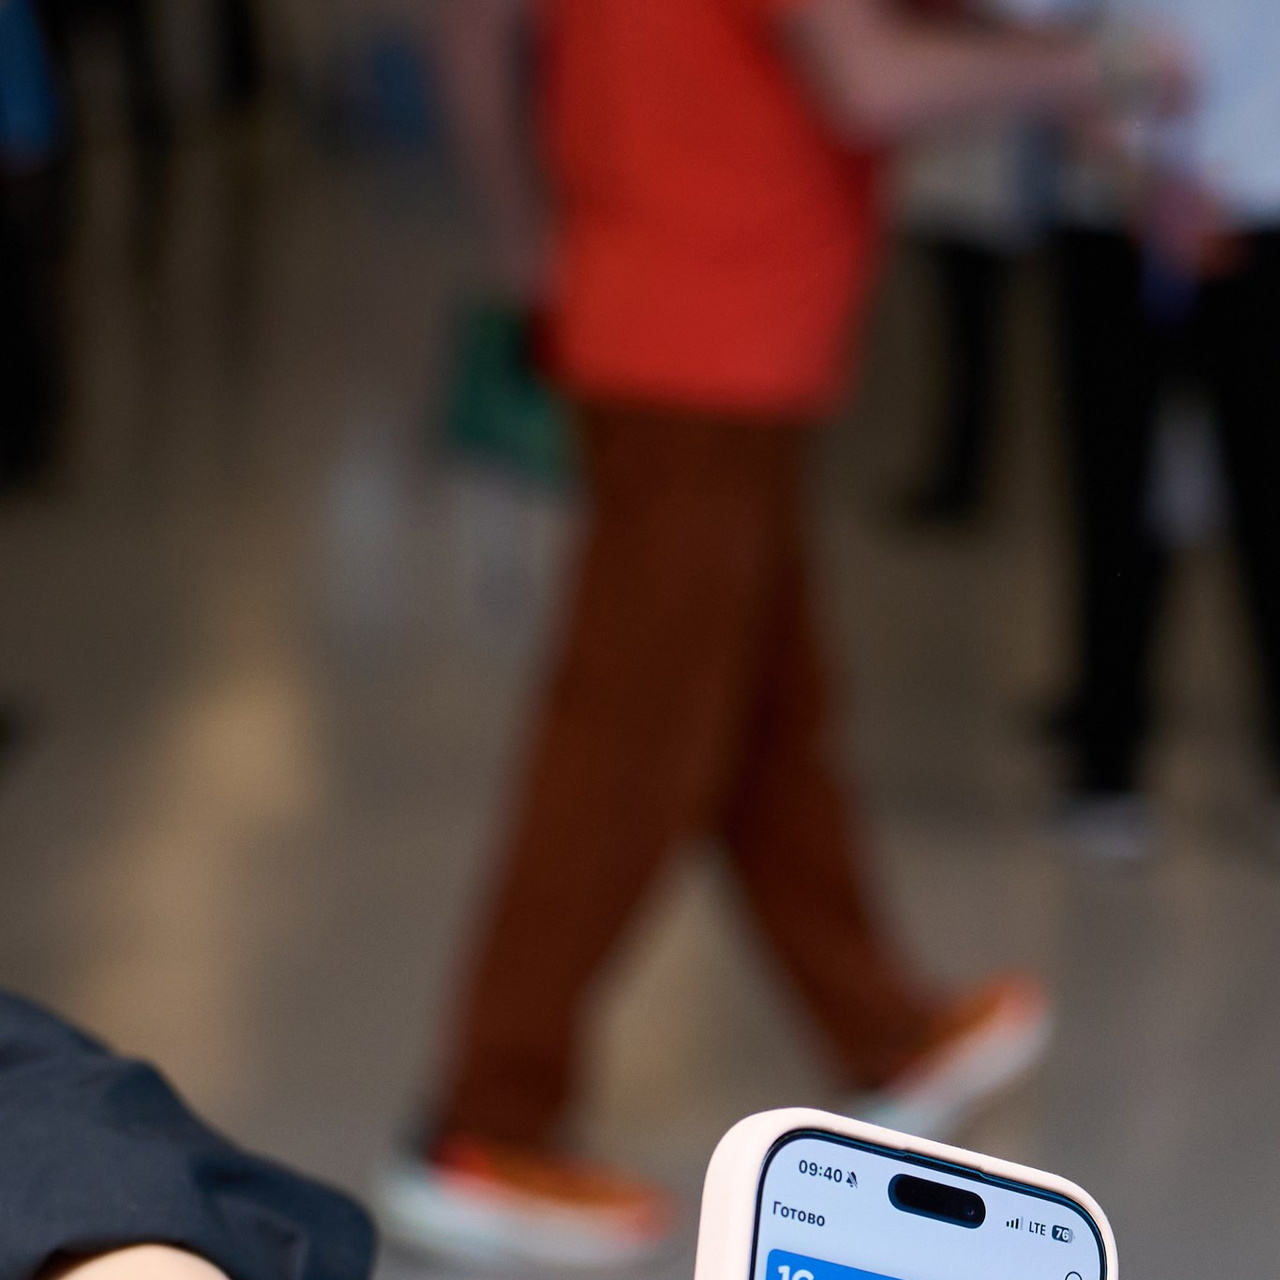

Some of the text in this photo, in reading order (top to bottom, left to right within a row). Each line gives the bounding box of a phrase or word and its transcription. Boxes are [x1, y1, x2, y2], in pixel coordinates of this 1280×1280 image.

[798, 1159, 843, 1184] 09:40
[772, 1200, 826, 1227] Готово
[1029, 1221, 1069, 1241] LTE 76
